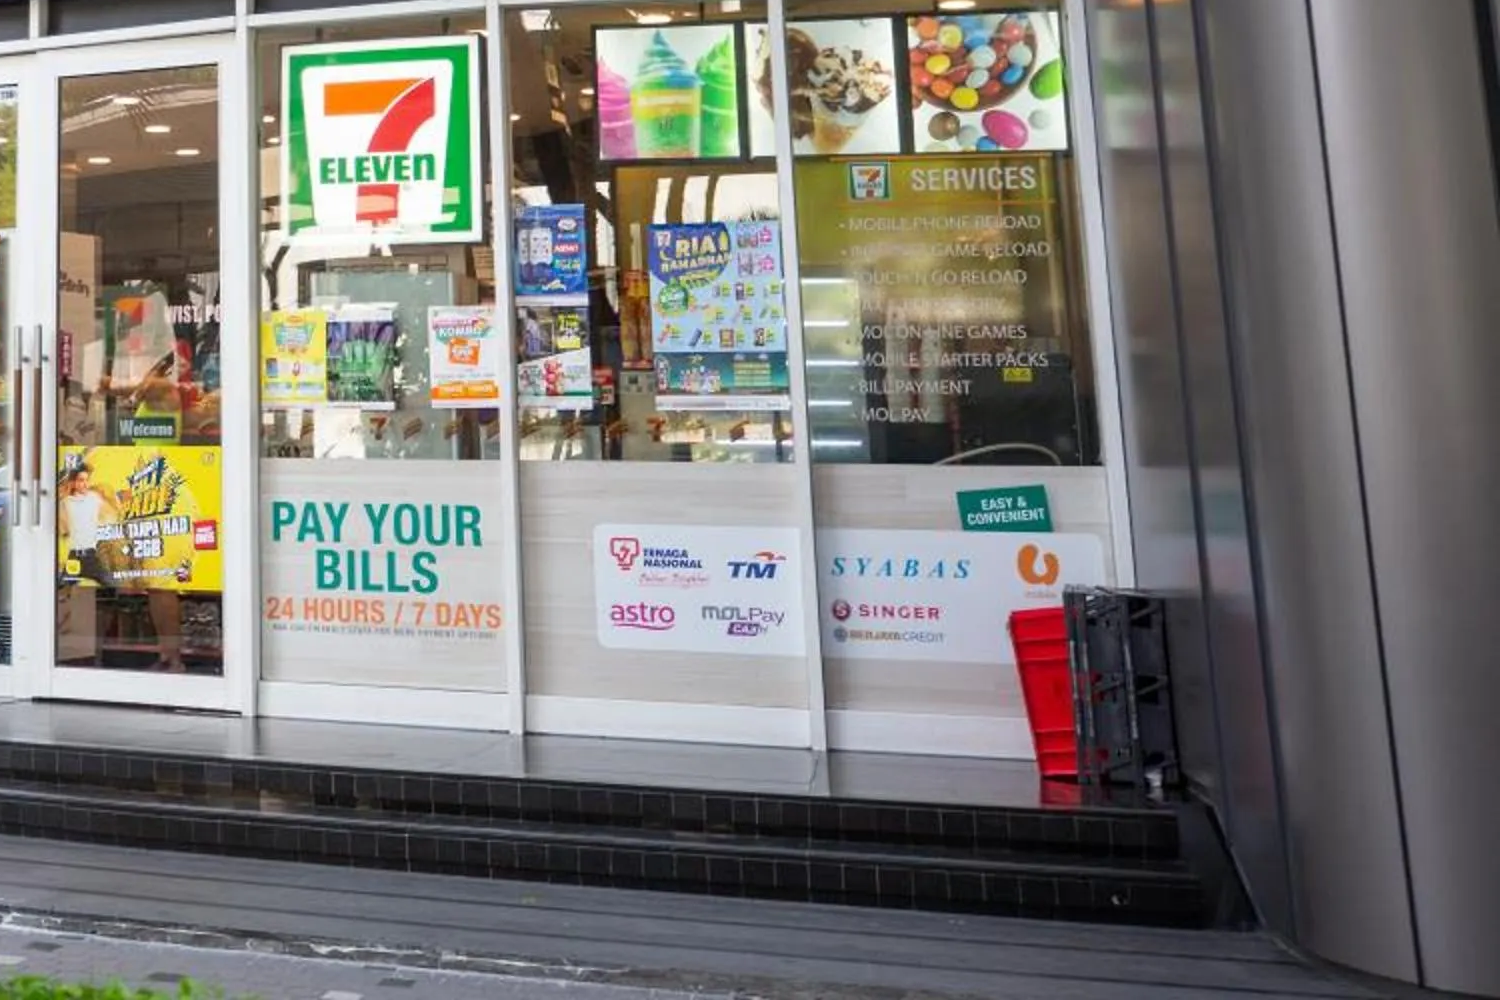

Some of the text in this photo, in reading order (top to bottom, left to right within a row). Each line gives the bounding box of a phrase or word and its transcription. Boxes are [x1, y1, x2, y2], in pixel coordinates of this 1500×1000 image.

[323, 76, 436, 221] 7
[911, 165, 1037, 192] SERVICES
[849, 214, 1041, 232] MOBILE PHONE RELOAD
[676, 233, 716, 259] RIA
[931, 242, 981, 258] GAME
[983, 240, 1050, 257] RELOAD
[931, 269, 958, 285] GO
[961, 269, 1028, 285] RELOAD
[967, 324, 1028, 339] GAMES
[923, 353, 992, 367] STARTER
[995, 352, 1050, 367] PACKS
[858, 379, 974, 395] BILL PAYMENT
[861, 407, 931, 422] MOL PAY
[119, 419, 173, 437] Welcome
[981, 496, 1027, 511] EASY &
[272, 501, 483, 547] PAY YOUR
[967, 507, 1045, 526] CONVENIENT
[643, 548, 689, 559] TENAGA
[316, 549, 439, 594] BILLS
[643, 559, 703, 569] NASIONAL
[727, 561, 777, 579] TM
[831, 557, 971, 579] SYABAS
[266, 597, 294, 620] 24
[304, 598, 385, 624] HOURS
[414, 602, 426, 626] 7
[436, 602, 502, 629] DAYS
[611, 602, 675, 623] astro
[859, 603, 940, 620] SINGER
